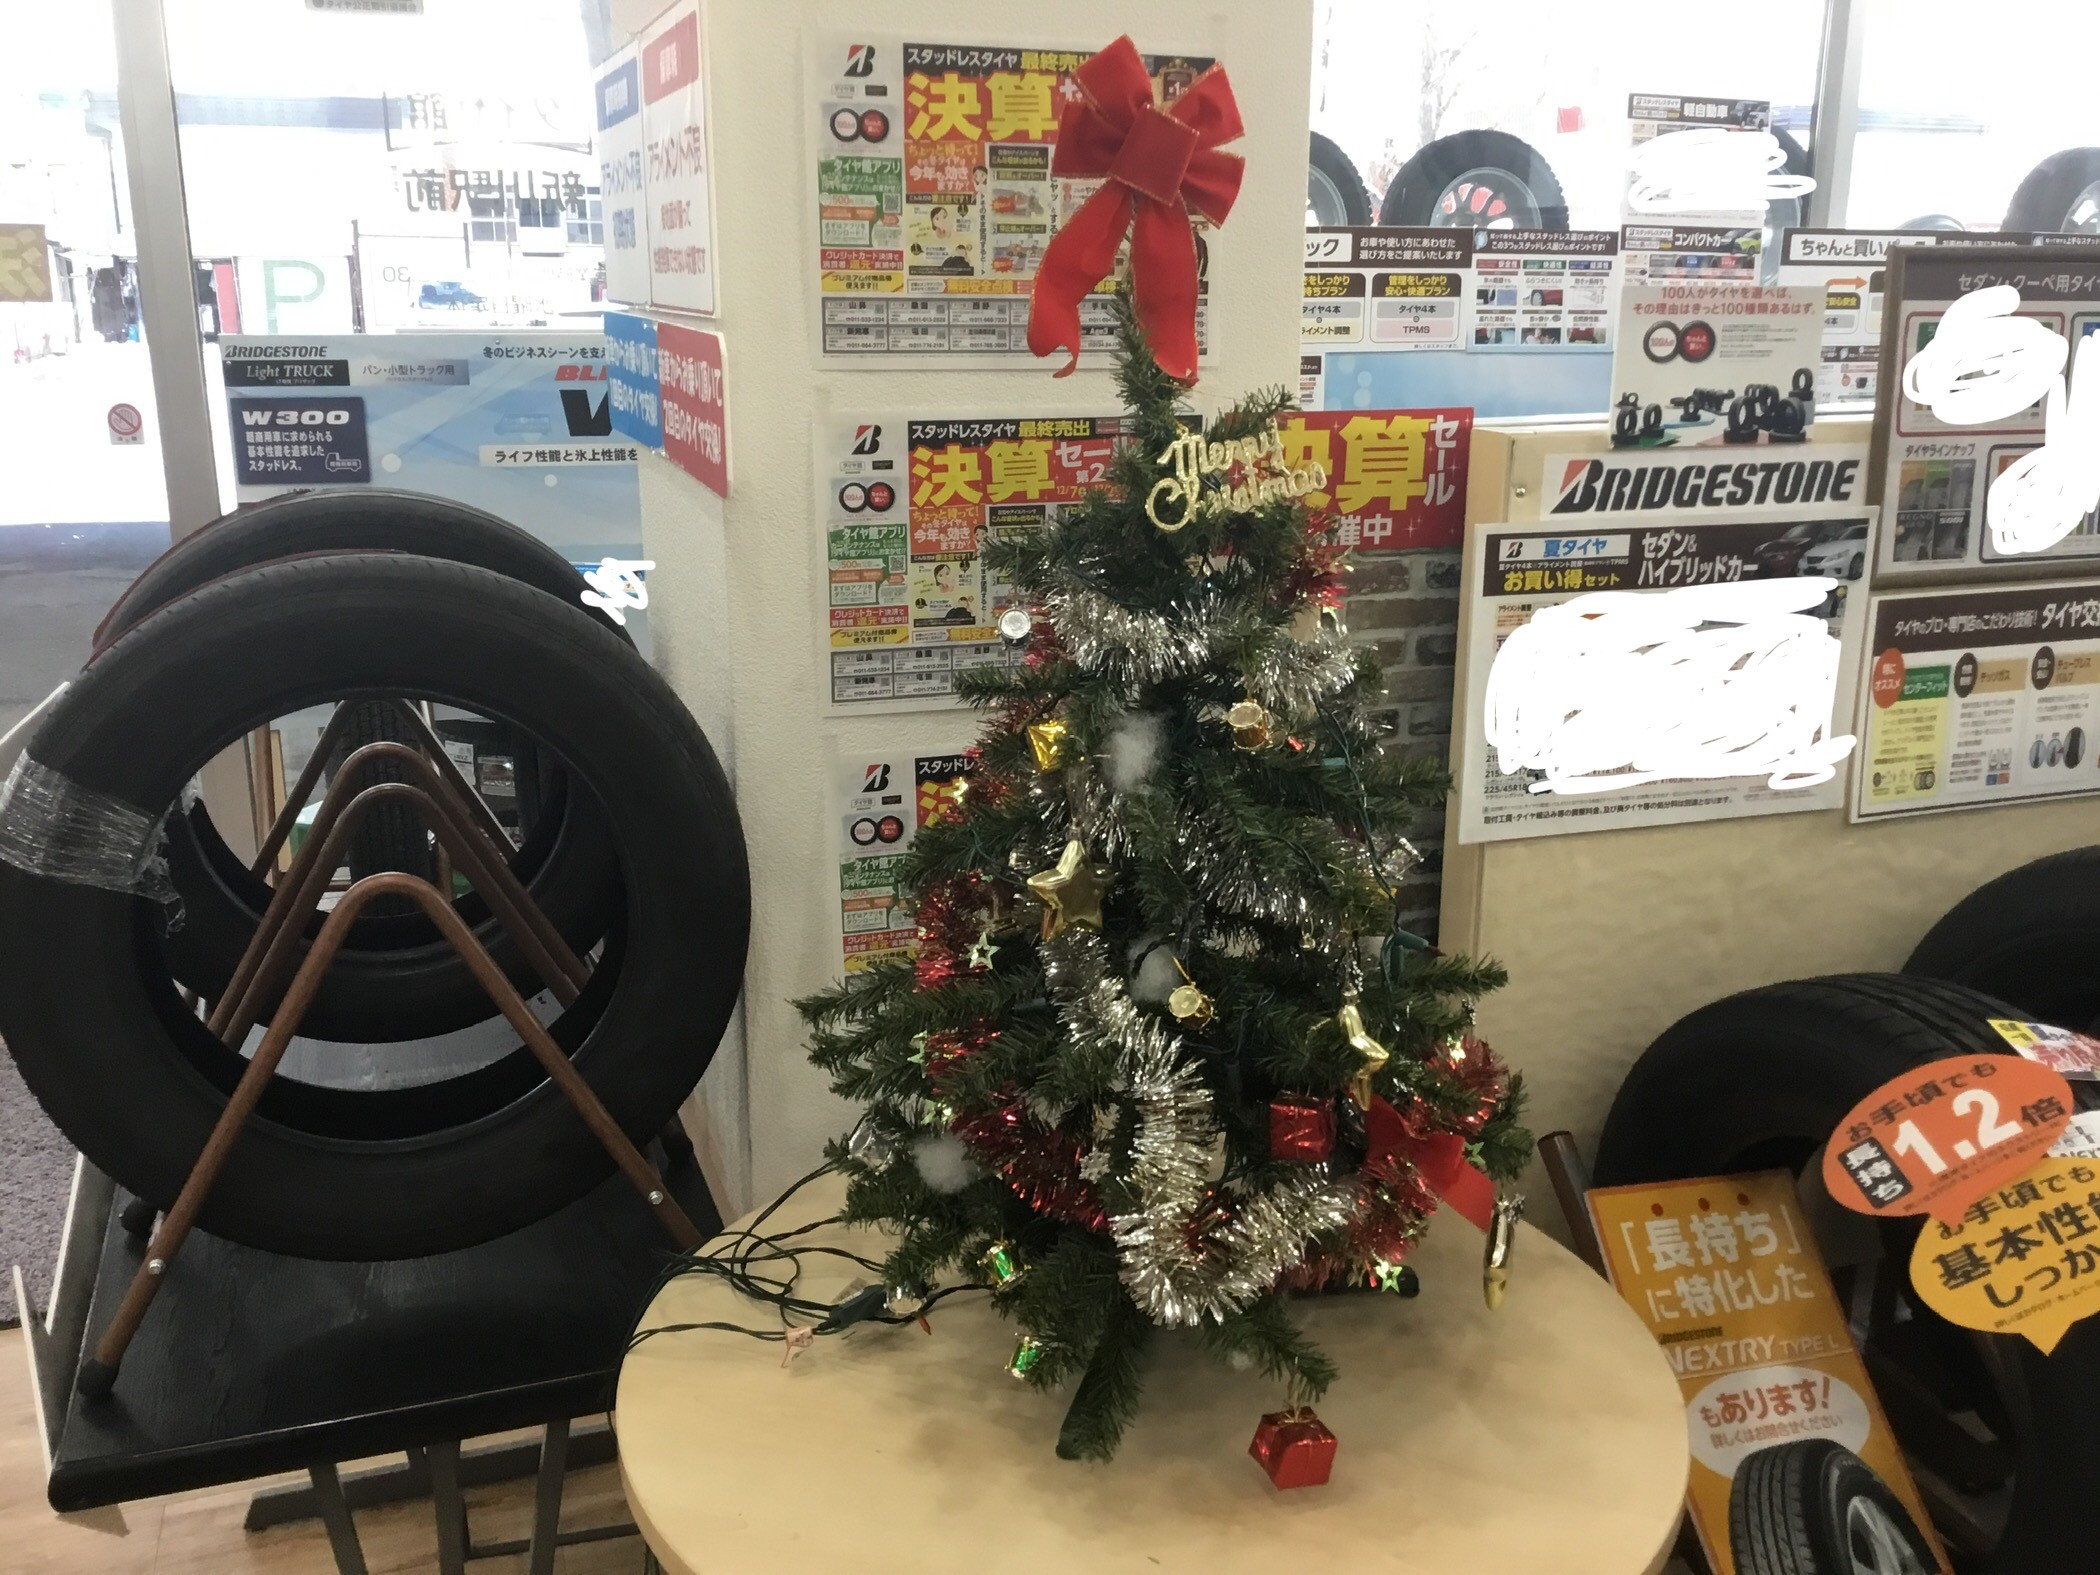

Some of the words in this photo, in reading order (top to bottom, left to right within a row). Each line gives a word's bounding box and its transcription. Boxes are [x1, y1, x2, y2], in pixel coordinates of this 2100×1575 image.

[908, 49, 1018, 69] スタッドレスタイヤ
[907, 72, 1059, 142] 決算
[1683, 102, 1729, 119] 軽自動車
[1360, 237, 1456, 248] お車や使い方にあわせた
[1359, 250, 1462, 260] 選び方をご提案いたします
[1389, 275, 1447, 286] 管理をしっかり
[1399, 305, 1436, 313] タイヤ4本
[1403, 326, 1430, 334] TPMS
[225, 345, 327, 358] BRIDGESTONE
[247, 365, 279, 380] Light
[284, 364, 333, 378] TRUCK
[912, 423, 1016, 439] スタッドレスタイヤ
[1018, 420, 1091, 437] 最終売出
[495, 449, 638, 463] ライフ性能と氷上性能を
[1156, 415, 1291, 482] Merry
[1423, 414, 1459, 507] セール
[911, 438, 1055, 508] 決算
[1549, 459, 1860, 514] BRIDGESTONE
[912, 506, 979, 522] ちょっと待って!
[842, 526, 906, 540] タイヤ館アプリ
[914, 526, 970, 543] 今年も効き
[1543, 538, 1608, 558] 夏タイヤ
[1503, 569, 1583, 592] お買い得
[1584, 573, 1621, 587] セット
[1637, 555, 1760, 587] ハイブリッドカー
[834, 608, 905, 619] クレジットカード決済で
[1874, 678, 1902, 691] オススメ
[919, 757, 975, 775] スタッドレ
[1484, 784, 1527, 794] 225/45R18
[1847, 1062, 1997, 1143] お手頃でも
[1845, 1141, 1905, 1202] 長持ち
[1892, 1088, 2024, 1175] 1.2
[2021, 1095, 2067, 1128] 倍
[1620, 1203, 1802, 1275] 「長持ち」
[1646, 1263, 1816, 1323] に特化した
[1658, 1326, 1723, 1346] BRIDGESTONE
[1666, 1335, 1775, 1374] NEXTRY
[1780, 1335, 1824, 1355] TYPE
[1827, 1334, 1839, 1349] L
[1699, 1376, 1831, 1428] もあります!
[1709, 1415, 1844, 1450] 詳しくはお問合せください
